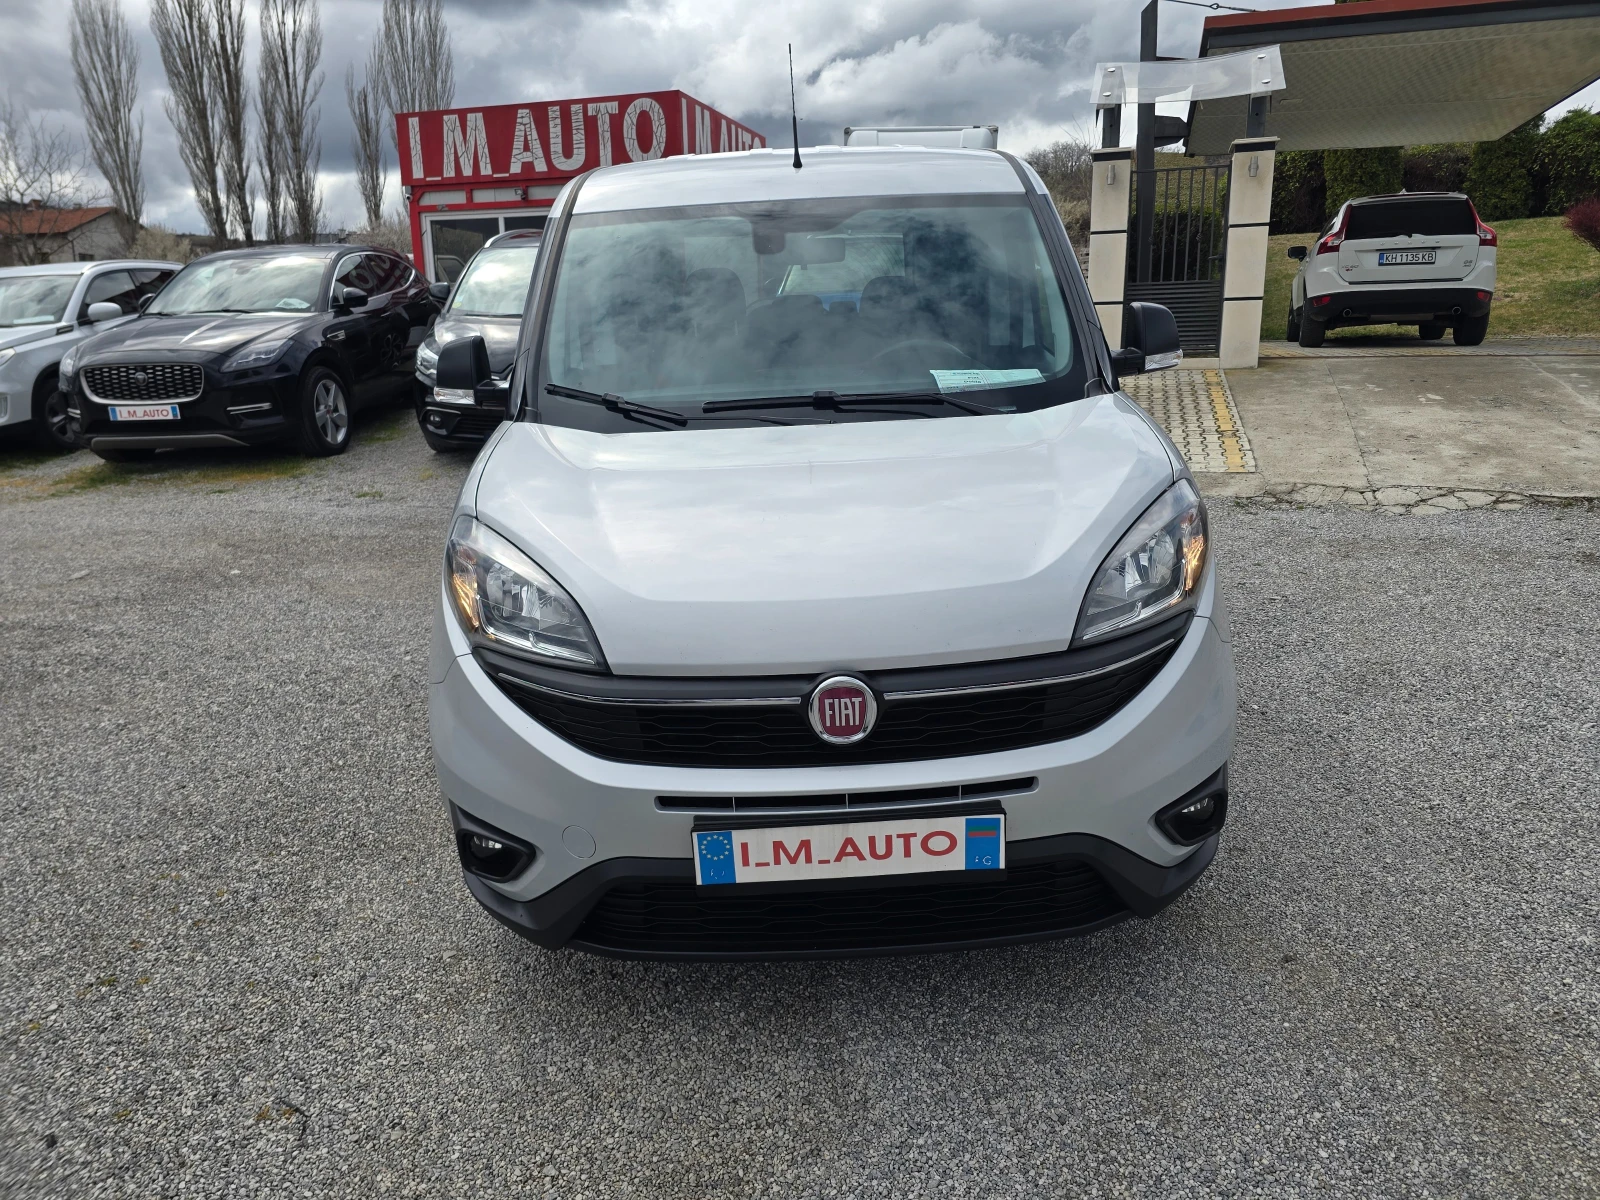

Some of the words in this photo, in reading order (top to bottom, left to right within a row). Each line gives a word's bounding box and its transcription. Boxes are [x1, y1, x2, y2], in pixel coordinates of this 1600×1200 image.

[1385, 254, 1398, 263] KH
[1399, 253, 1420, 262] 1135
[1421, 252, 1434, 262] KB
[824, 697, 863, 727] FIAT
[741, 830, 958, 869] I_M_AUTO
